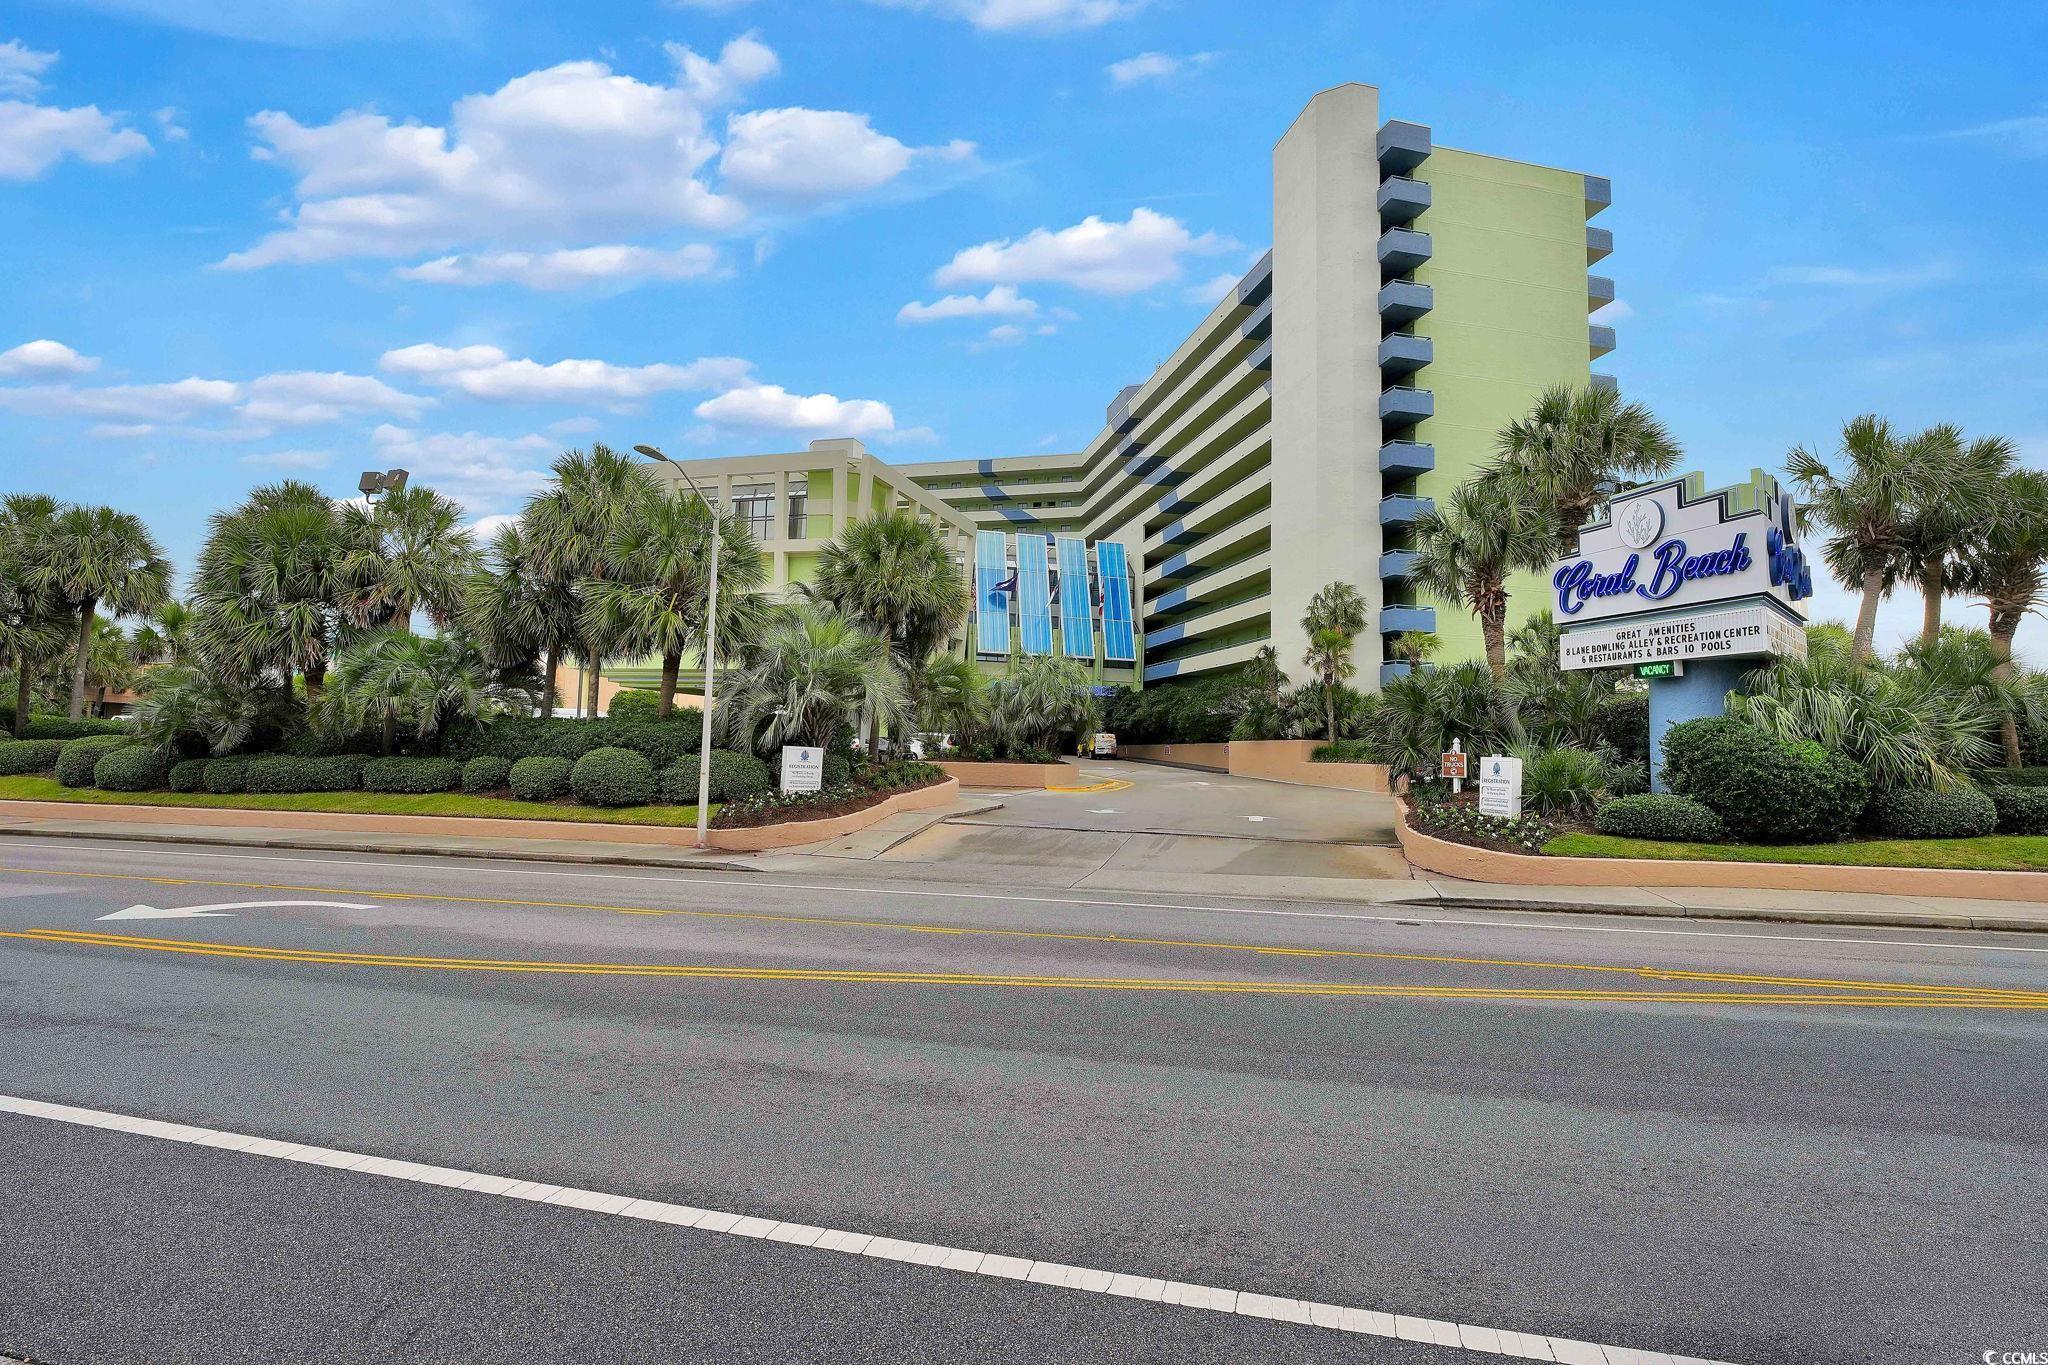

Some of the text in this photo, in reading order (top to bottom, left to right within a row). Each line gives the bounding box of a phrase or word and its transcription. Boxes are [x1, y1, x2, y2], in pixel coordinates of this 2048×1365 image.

[1553, 554, 1640, 614] Coral
[1636, 533, 1753, 600] Beach
[1566, 625, 1761, 656] 8 LANE BOWLING ALLEY & RECREATION CENTER
[1616, 622, 1696, 641] GREAT AMENITIES
[1581, 655, 1587, 664] 6
[1588, 649, 1643, 664] RESTAURANTS
[1646, 648, 1652, 657] &
[1656, 645, 1679, 656] BARS
[1701, 640, 1732, 652] POOLS
[1640, 663, 1670, 676] VACANCY
